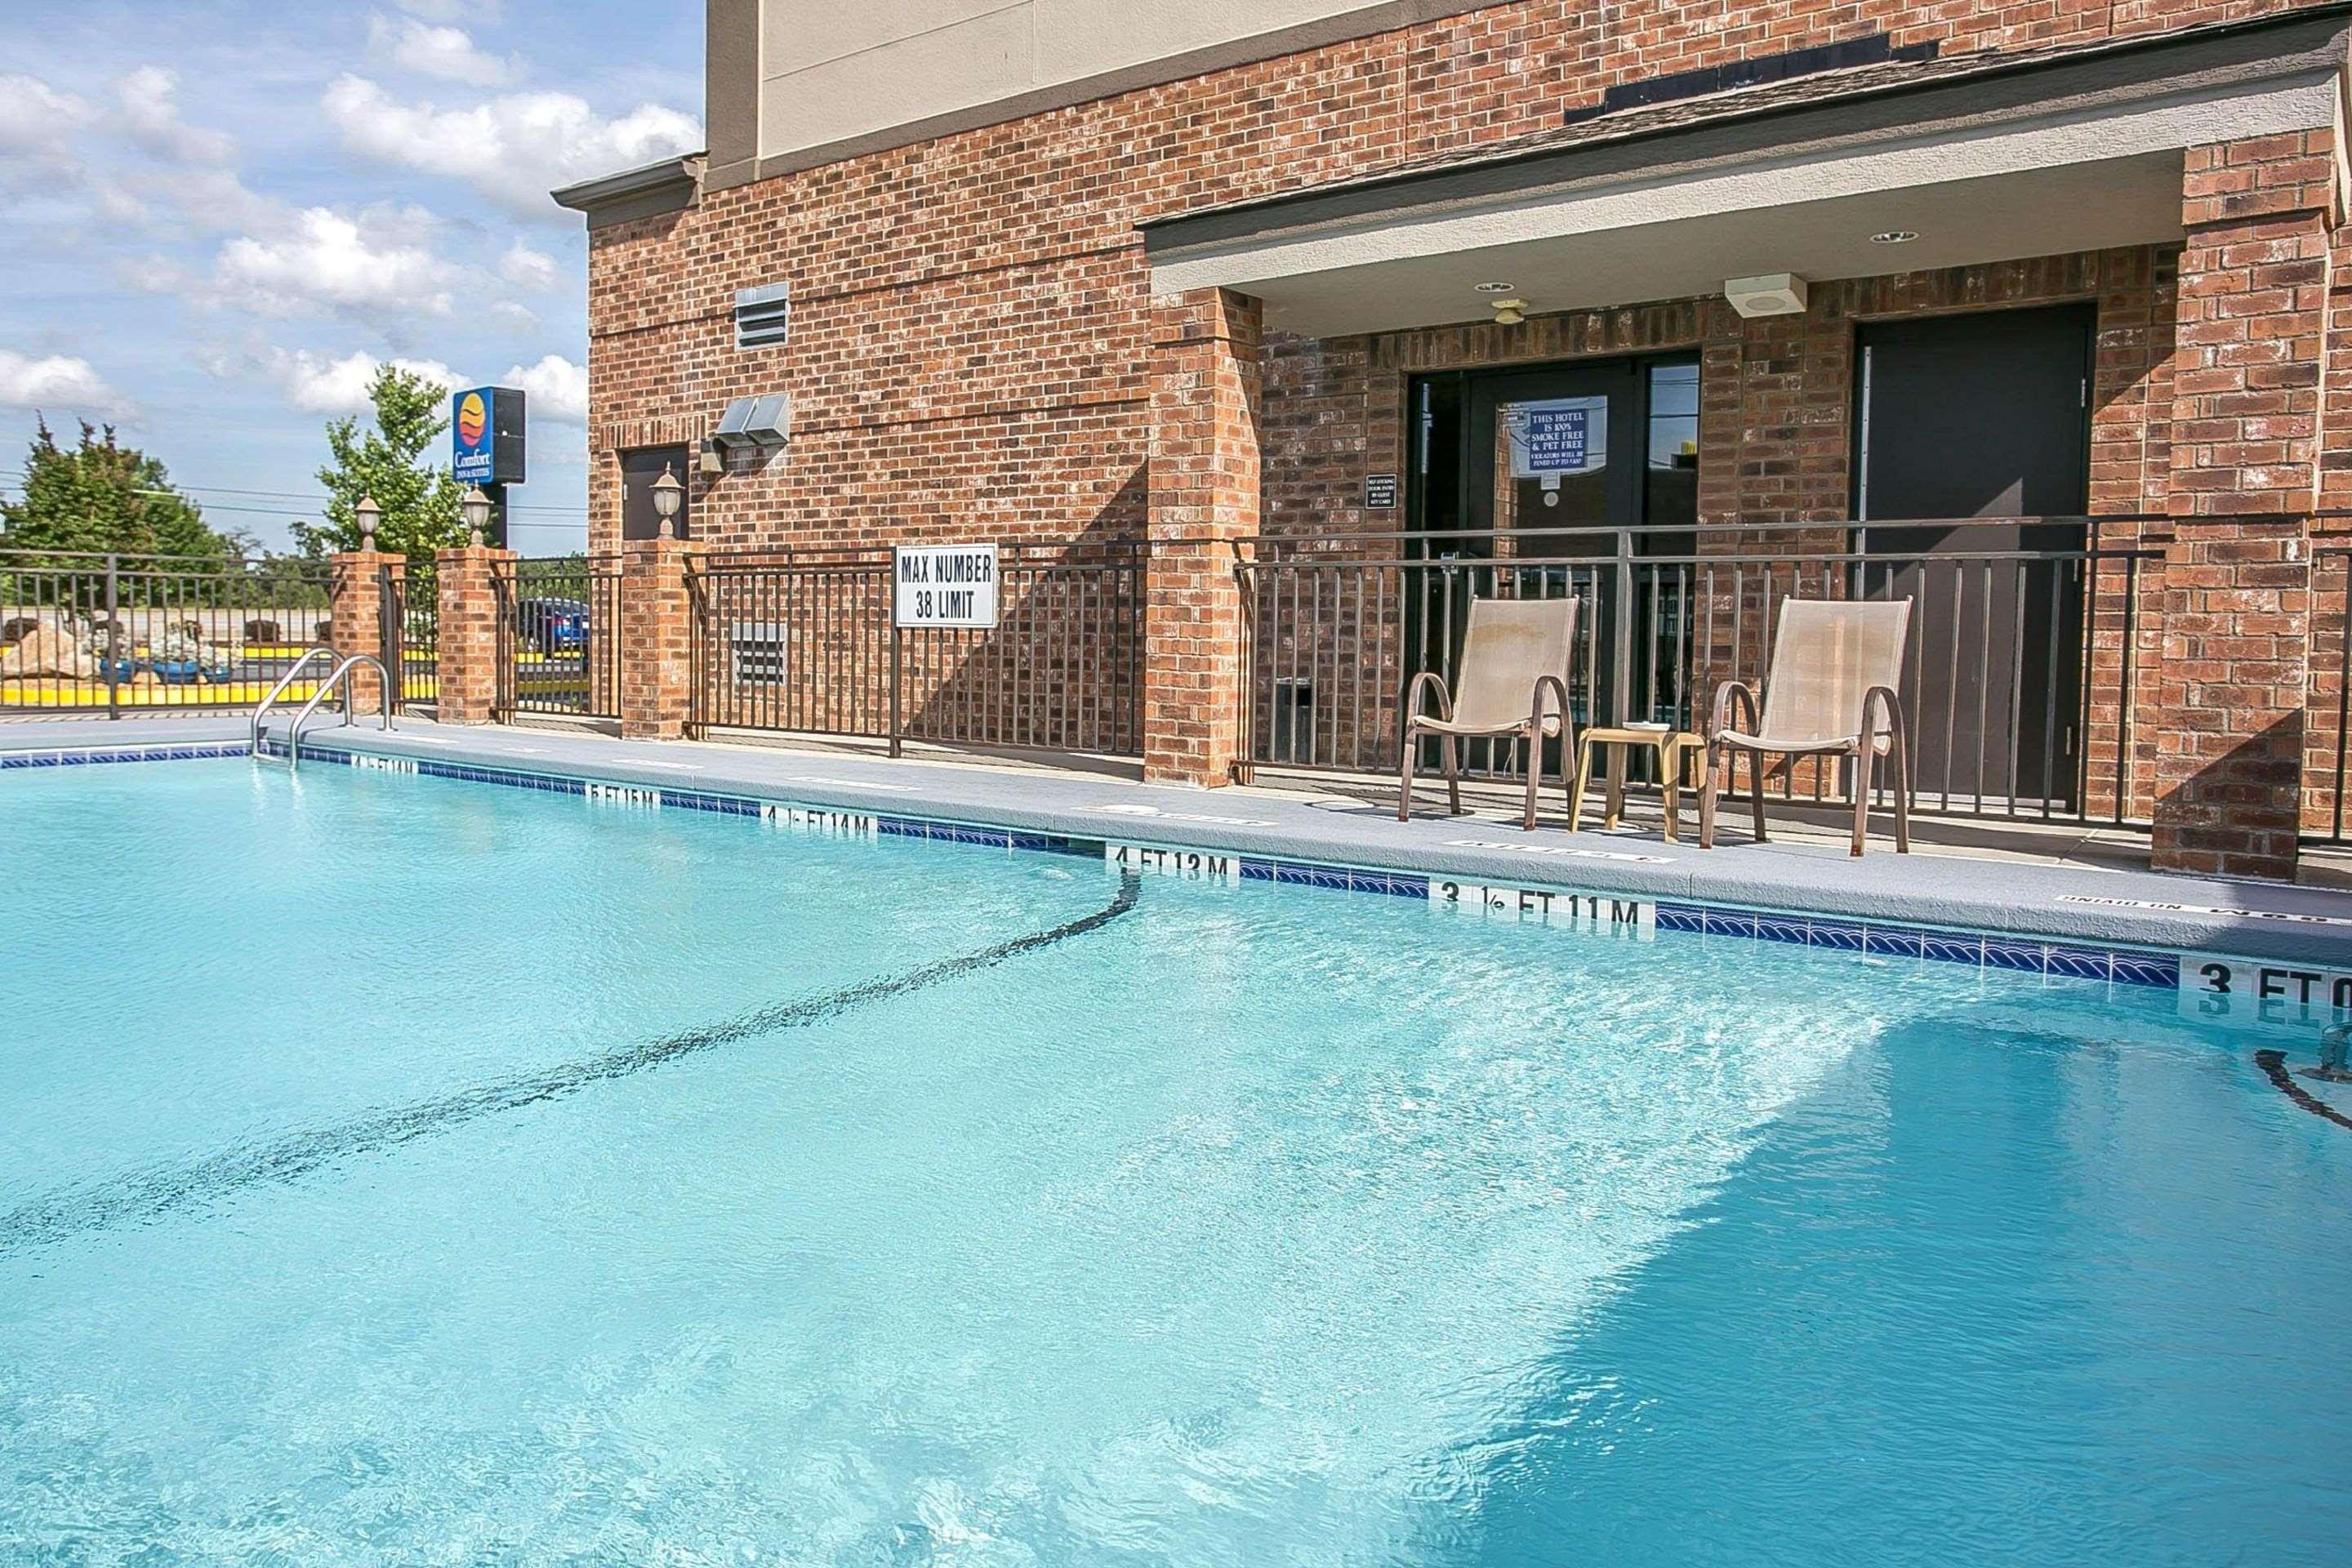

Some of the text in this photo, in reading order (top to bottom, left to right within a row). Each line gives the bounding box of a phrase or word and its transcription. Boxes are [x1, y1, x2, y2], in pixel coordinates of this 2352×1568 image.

[1532, 414, 1553, 423] THIS
[1555, 412, 1584, 422] HOTEL
[1544, 424, 1552, 432] IS
[1531, 430, 1584, 442] SMOKE FREE
[1532, 440, 1584, 451] & PET FREE
[455, 448, 490, 468] Comfort
[902, 555, 991, 583] MAX NUMBER
[916, 590, 974, 619] 38 LIMIT
[1140, 848, 1167, 867] FT
[1208, 856, 1227, 875] M
[1441, 882, 1459, 902] 3
[1519, 889, 1555, 914] FT
[1611, 899, 1639, 925] M
[2199, 963, 2232, 994] 3
[2260, 968, 2323, 1004] FT
